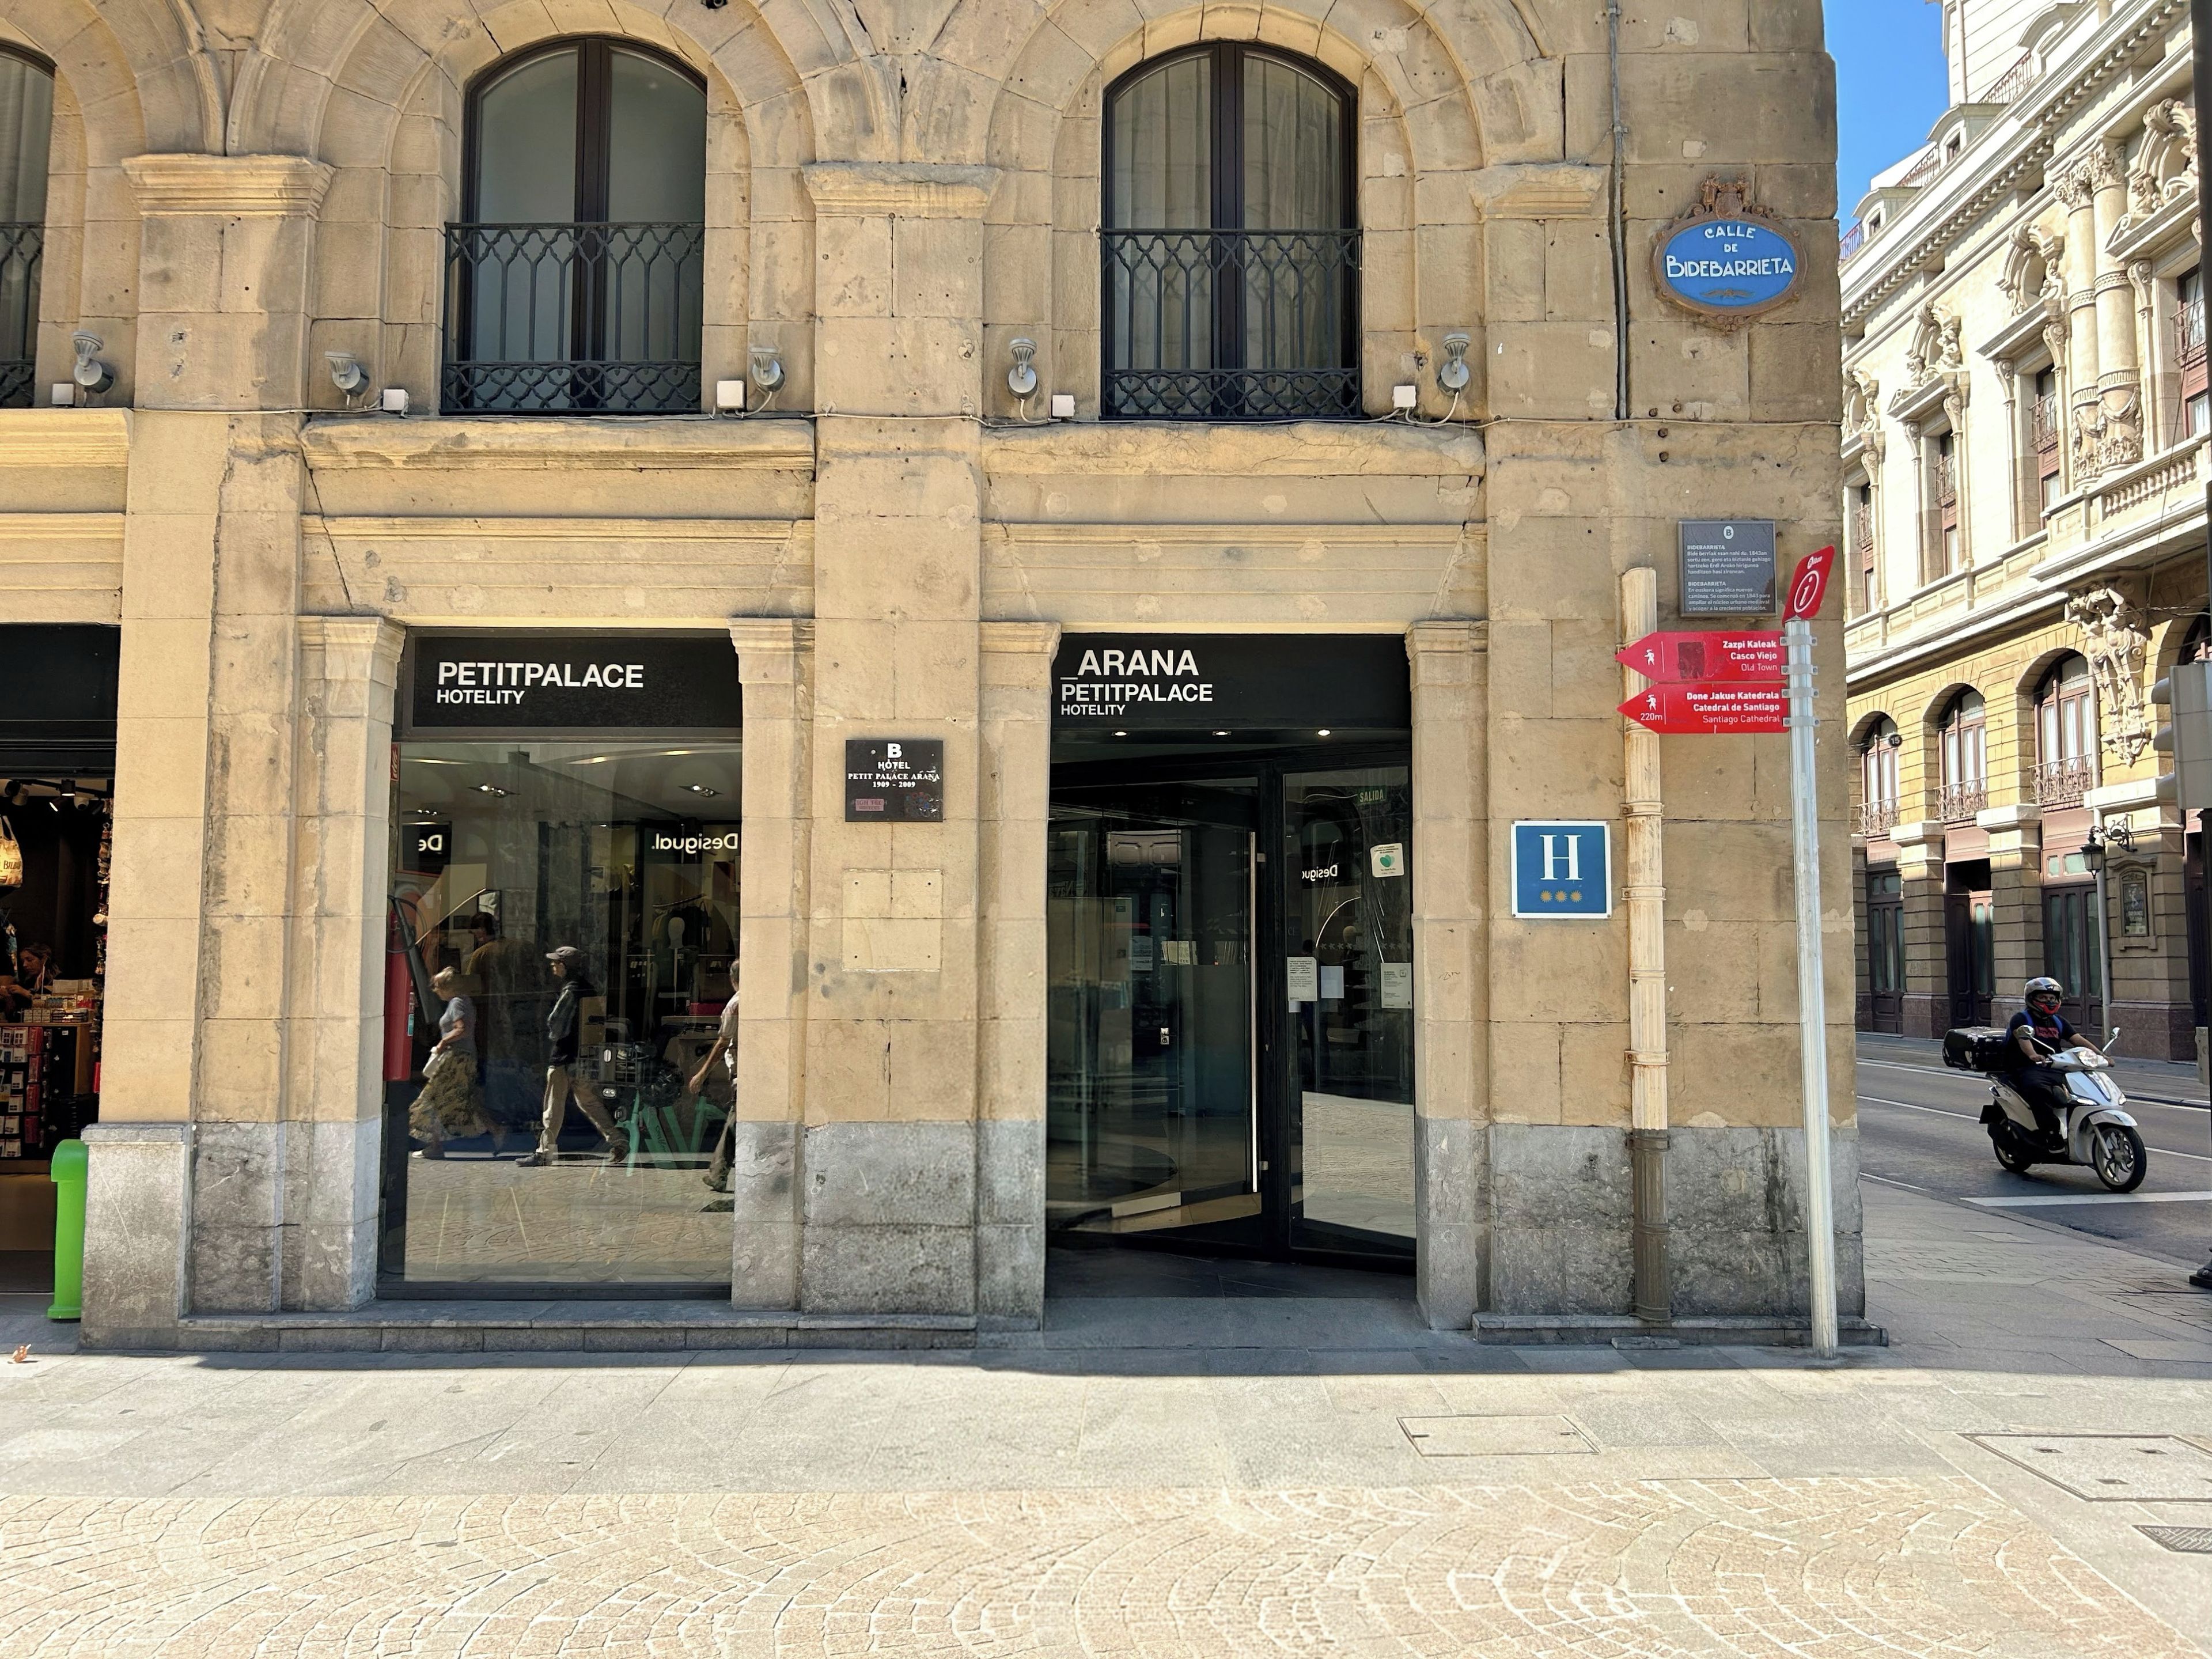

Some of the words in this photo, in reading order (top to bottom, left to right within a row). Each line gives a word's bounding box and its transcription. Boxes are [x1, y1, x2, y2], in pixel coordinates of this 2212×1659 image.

[1704, 225, 1756, 239] CALLE
[1724, 243, 1738, 253] DE
[1665, 255, 1793, 278] BIDEBARRIETA
[1722, 641, 1745, 650] Zazpi
[1747, 640, 1777, 648] Kaleak
[1730, 652, 1755, 660] Casco
[1756, 651, 1777, 661] Viejo
[1741, 663, 1755, 671] Old
[1756, 663, 1777, 671] Town
[438, 661, 645, 688] PETITPALACE
[437, 689, 525, 704] HOTELITY
[1061, 683, 1213, 702] PETITPALACE
[1686, 692, 1708, 700] Done
[1709, 692, 1735, 700] Jakue
[1737, 692, 1779, 700] Katedrala
[1061, 704, 1126, 716] HOTELITY
[1693, 703, 1730, 712] Catedral
[1743, 703, 1780, 713] Santiago
[1640, 713, 1662, 721] 220m
[1702, 715, 1738, 725] Santiago
[1740, 715, 1780, 723] Cathedral
[887, 743, 903, 759] B
[877, 761, 911, 770] HOTEL
[1359, 790, 1384, 803] SALIDA
[1539, 834, 1583, 880] H
